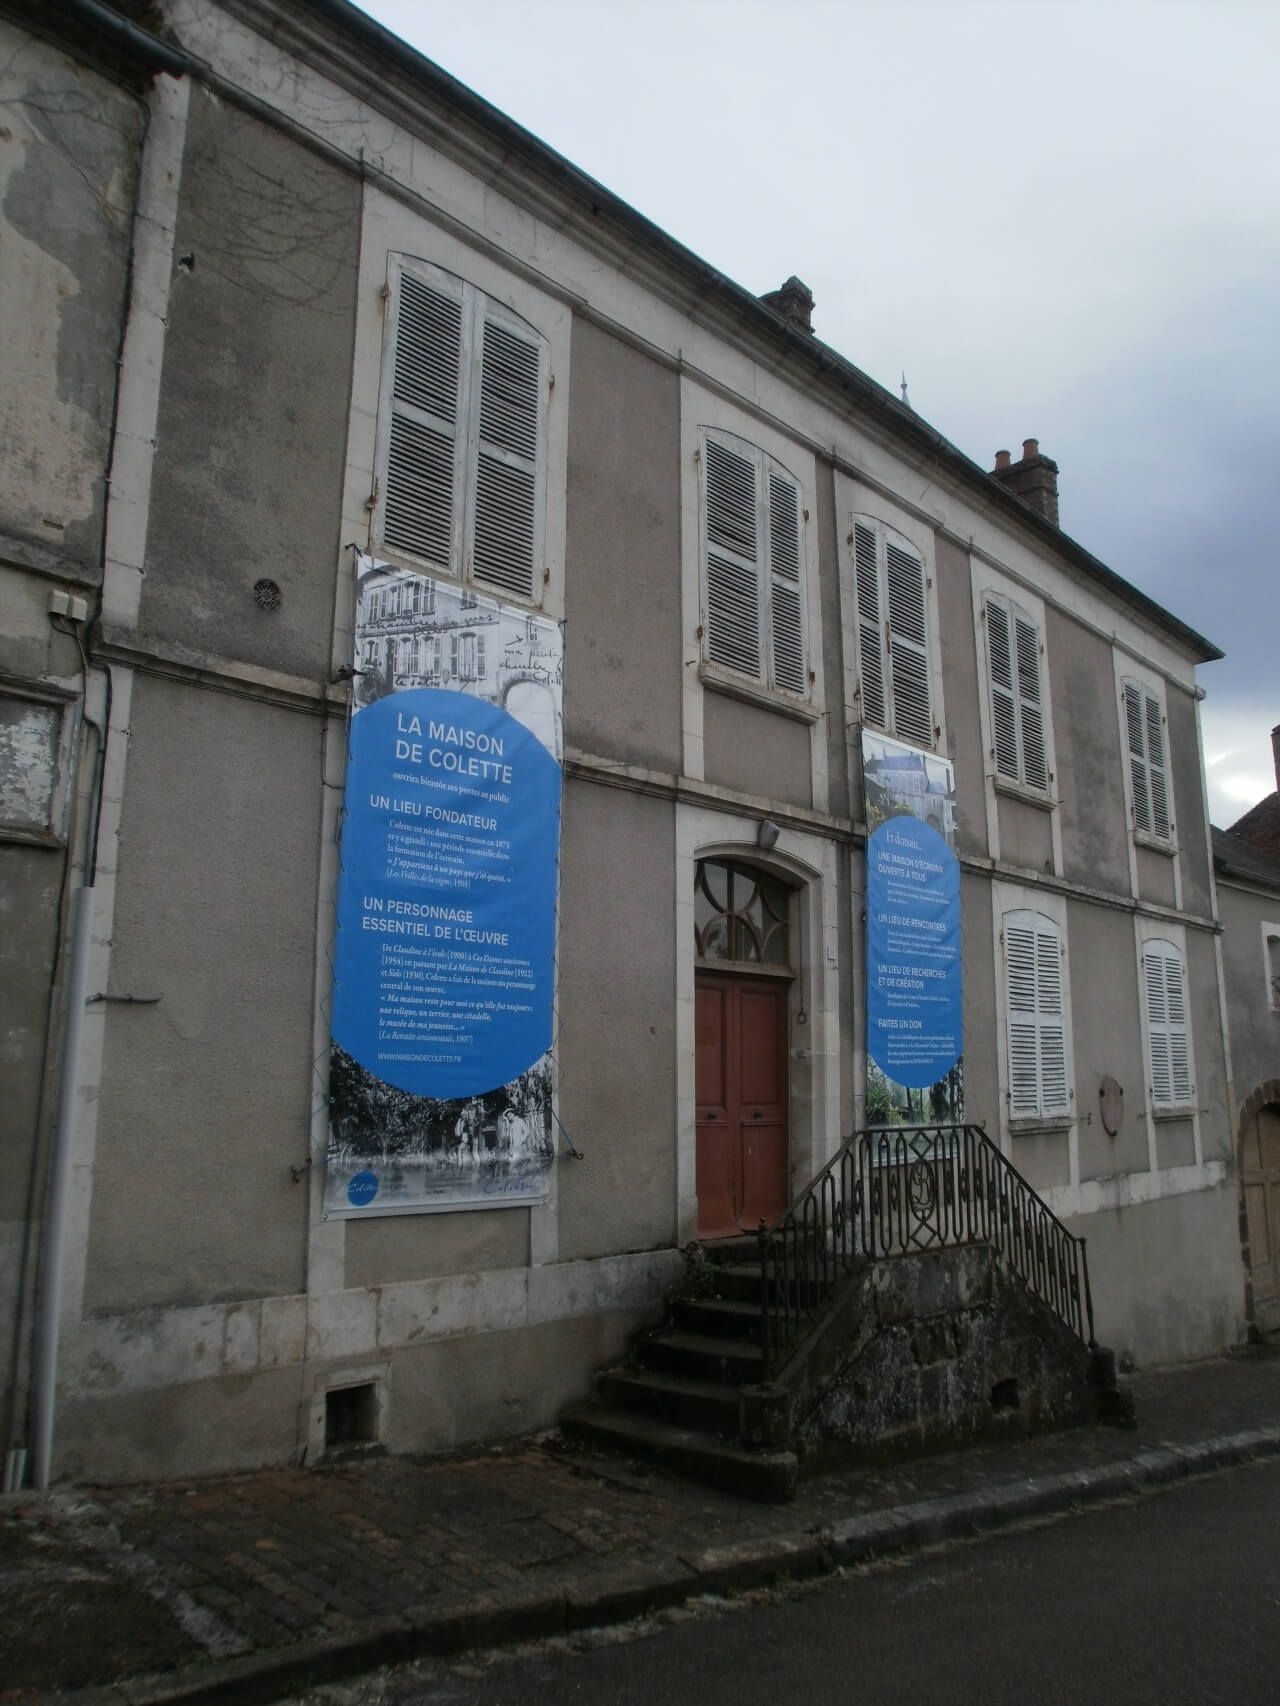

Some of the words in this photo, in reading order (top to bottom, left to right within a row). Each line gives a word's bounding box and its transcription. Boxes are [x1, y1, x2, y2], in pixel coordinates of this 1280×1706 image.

[397, 712, 422, 736] LA
[429, 720, 503, 756] MAISON
[396, 740, 423, 763] DE
[429, 749, 512, 784] COLETTE
[393, 772, 419, 783] ouvrira
[421, 776, 446, 789] bientôt
[459, 786, 480, 797] portes
[370, 794, 389, 809] UN
[394, 800, 421, 815] LIEU
[425, 806, 497, 831] FONDATEUR
[389, 820, 412, 831] Colette
[424, 826, 434, 835] née
[395, 845, 426, 858] formation
[405, 836, 426, 846] grandi
[442, 843, 464, 853] période
[878, 851, 891, 862] UNE
[892, 854, 913, 868] MAISON
[449, 867, 463, 877] pays
[464, 870, 475, 879] que
[878, 864, 904, 878] OUVERTE
[912, 871, 926, 881] TOUS
[364, 897, 383, 911] UN
[387, 900, 473, 923] PERSONNAGE
[888, 914, 901, 924] LIEU
[362, 917, 430, 937] ESSENTIEL
[435, 926, 451, 939] DE
[455, 928, 508, 946] L'ŒUVRE
[393, 944, 421, 956] Claudine
[447, 950, 467, 961] (1900)
[413, 959, 436, 970] passant
[437, 963, 447, 972] par
[459, 963, 480, 973] Maison
[489, 967, 514, 976] Claudine
[888, 965, 901, 975] LIEU
[426, 973, 447, 982] Colette
[478, 978, 497, 986] maison
[400, 996, 423, 1004] maison
[425, 997, 439, 1005] reste
[456, 1000, 468, 1008] moi
[496, 1003, 506, 1011] fut
[387, 1020, 406, 1028] musée
[878, 1019, 898, 1028] FAITES
[900, 1020, 908, 1028] UN
[909, 1020, 922, 1029] DON
[391, 1031, 416, 1041] Retraite
